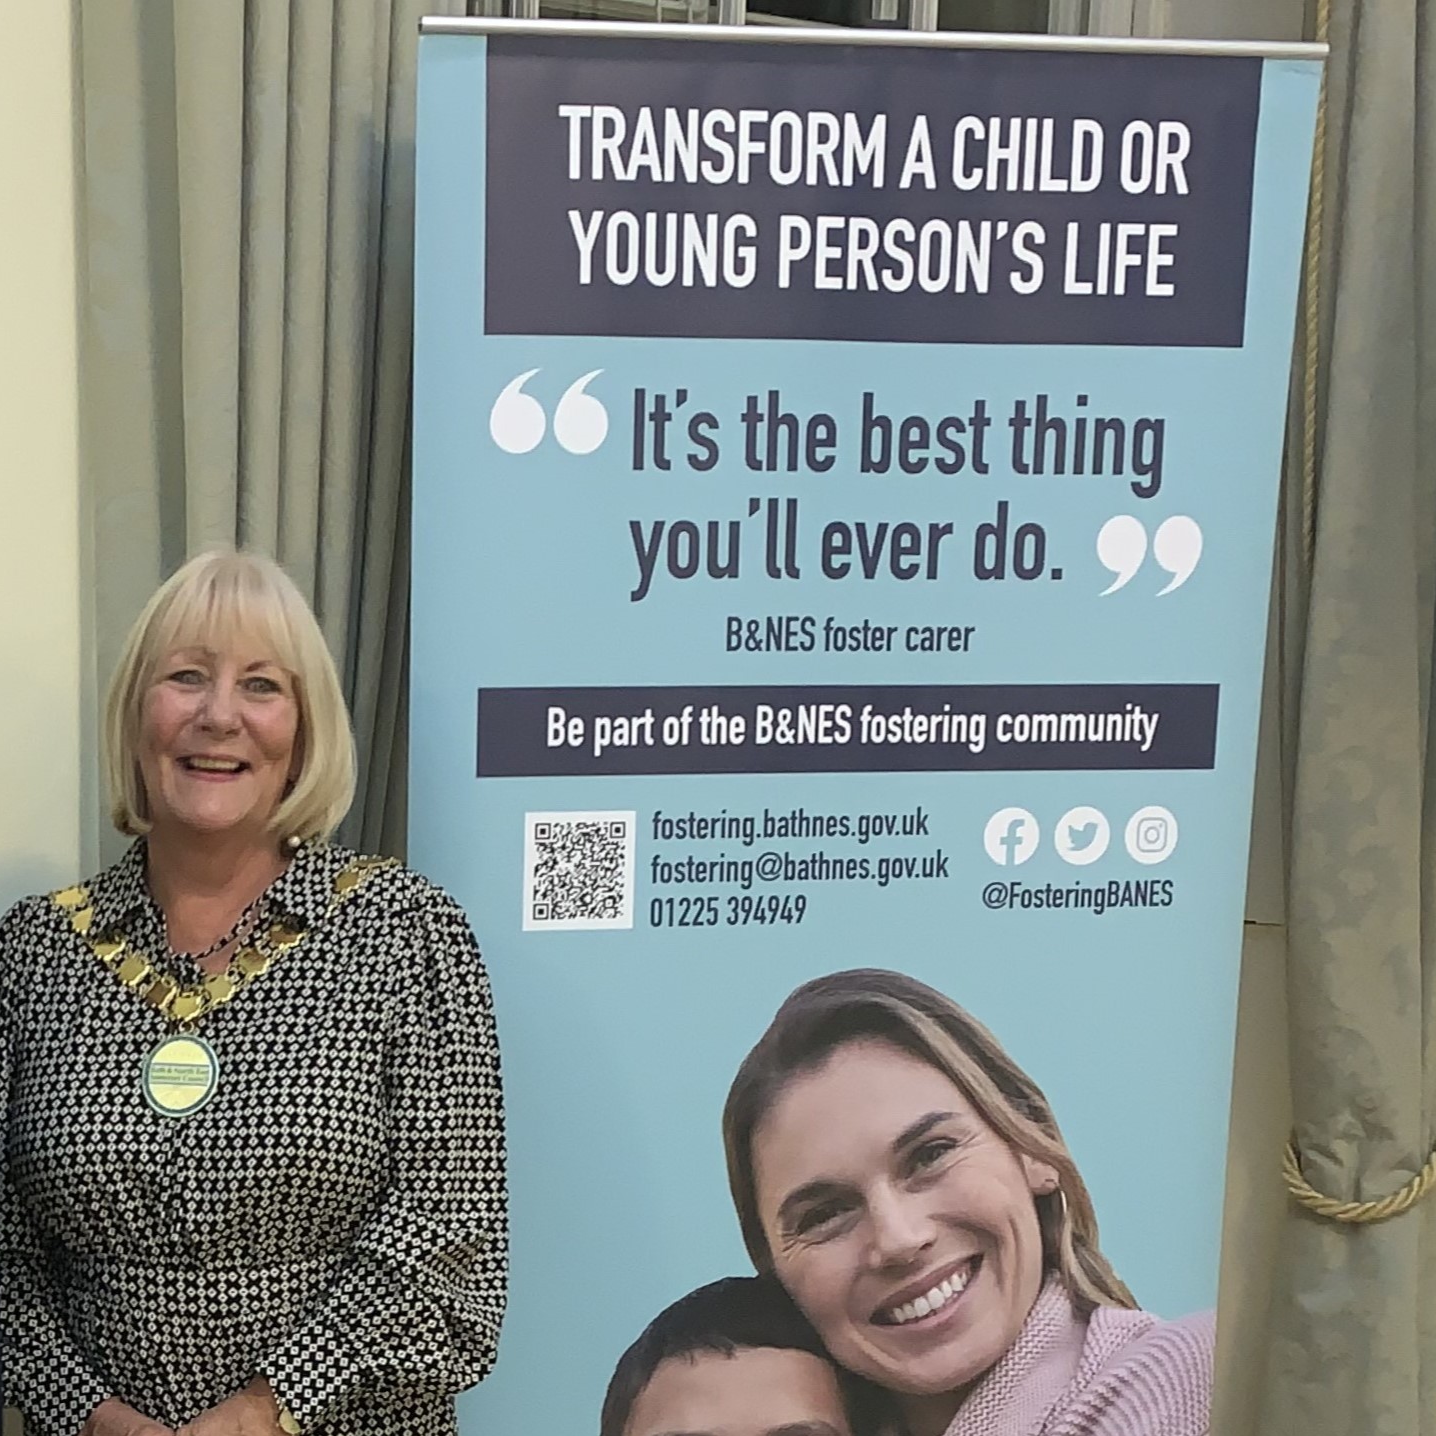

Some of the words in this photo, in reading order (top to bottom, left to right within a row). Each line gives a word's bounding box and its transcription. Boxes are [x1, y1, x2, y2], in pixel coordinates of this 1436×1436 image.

[558, 104, 887, 188] TRANSFORM
[899, 115, 937, 190] A
[952, 115, 1104, 193] CHILD
[1120, 120, 1191, 195] OR
[568, 209, 757, 288] YOUNG
[778, 214, 1046, 295] PERSON’S
[1064, 221, 1178, 296] LIFE
[632, 387, 720, 472] It’s
[740, 389, 837, 473] the
[860, 391, 992, 475] best
[1008, 394, 1165, 499] thing
[628, 497, 801, 603] you’ll
[821, 521, 954, 581] ever
[973, 500, 1063, 581] do.
[726, 615, 816, 652] B&NES
[823, 616, 899, 652] foster
[905, 626, 976, 652] carer
[547, 706, 585, 747] Be
[594, 708, 655, 757] part
[662, 705, 694, 746] of
[698, 705, 746, 745] the
[755, 704, 852, 745] B&NES
[859, 704, 987, 754] fostering
[996, 703, 1159, 752] community
[652, 806, 929, 847] fostering.bathnes.gov.uk
[650, 848, 949, 890] fostering@bathnes.gov.uk
[650, 896, 720, 928] 01225
[726, 894, 807, 926] 394949
[982, 879, 1174, 916] @FosteringBANES
